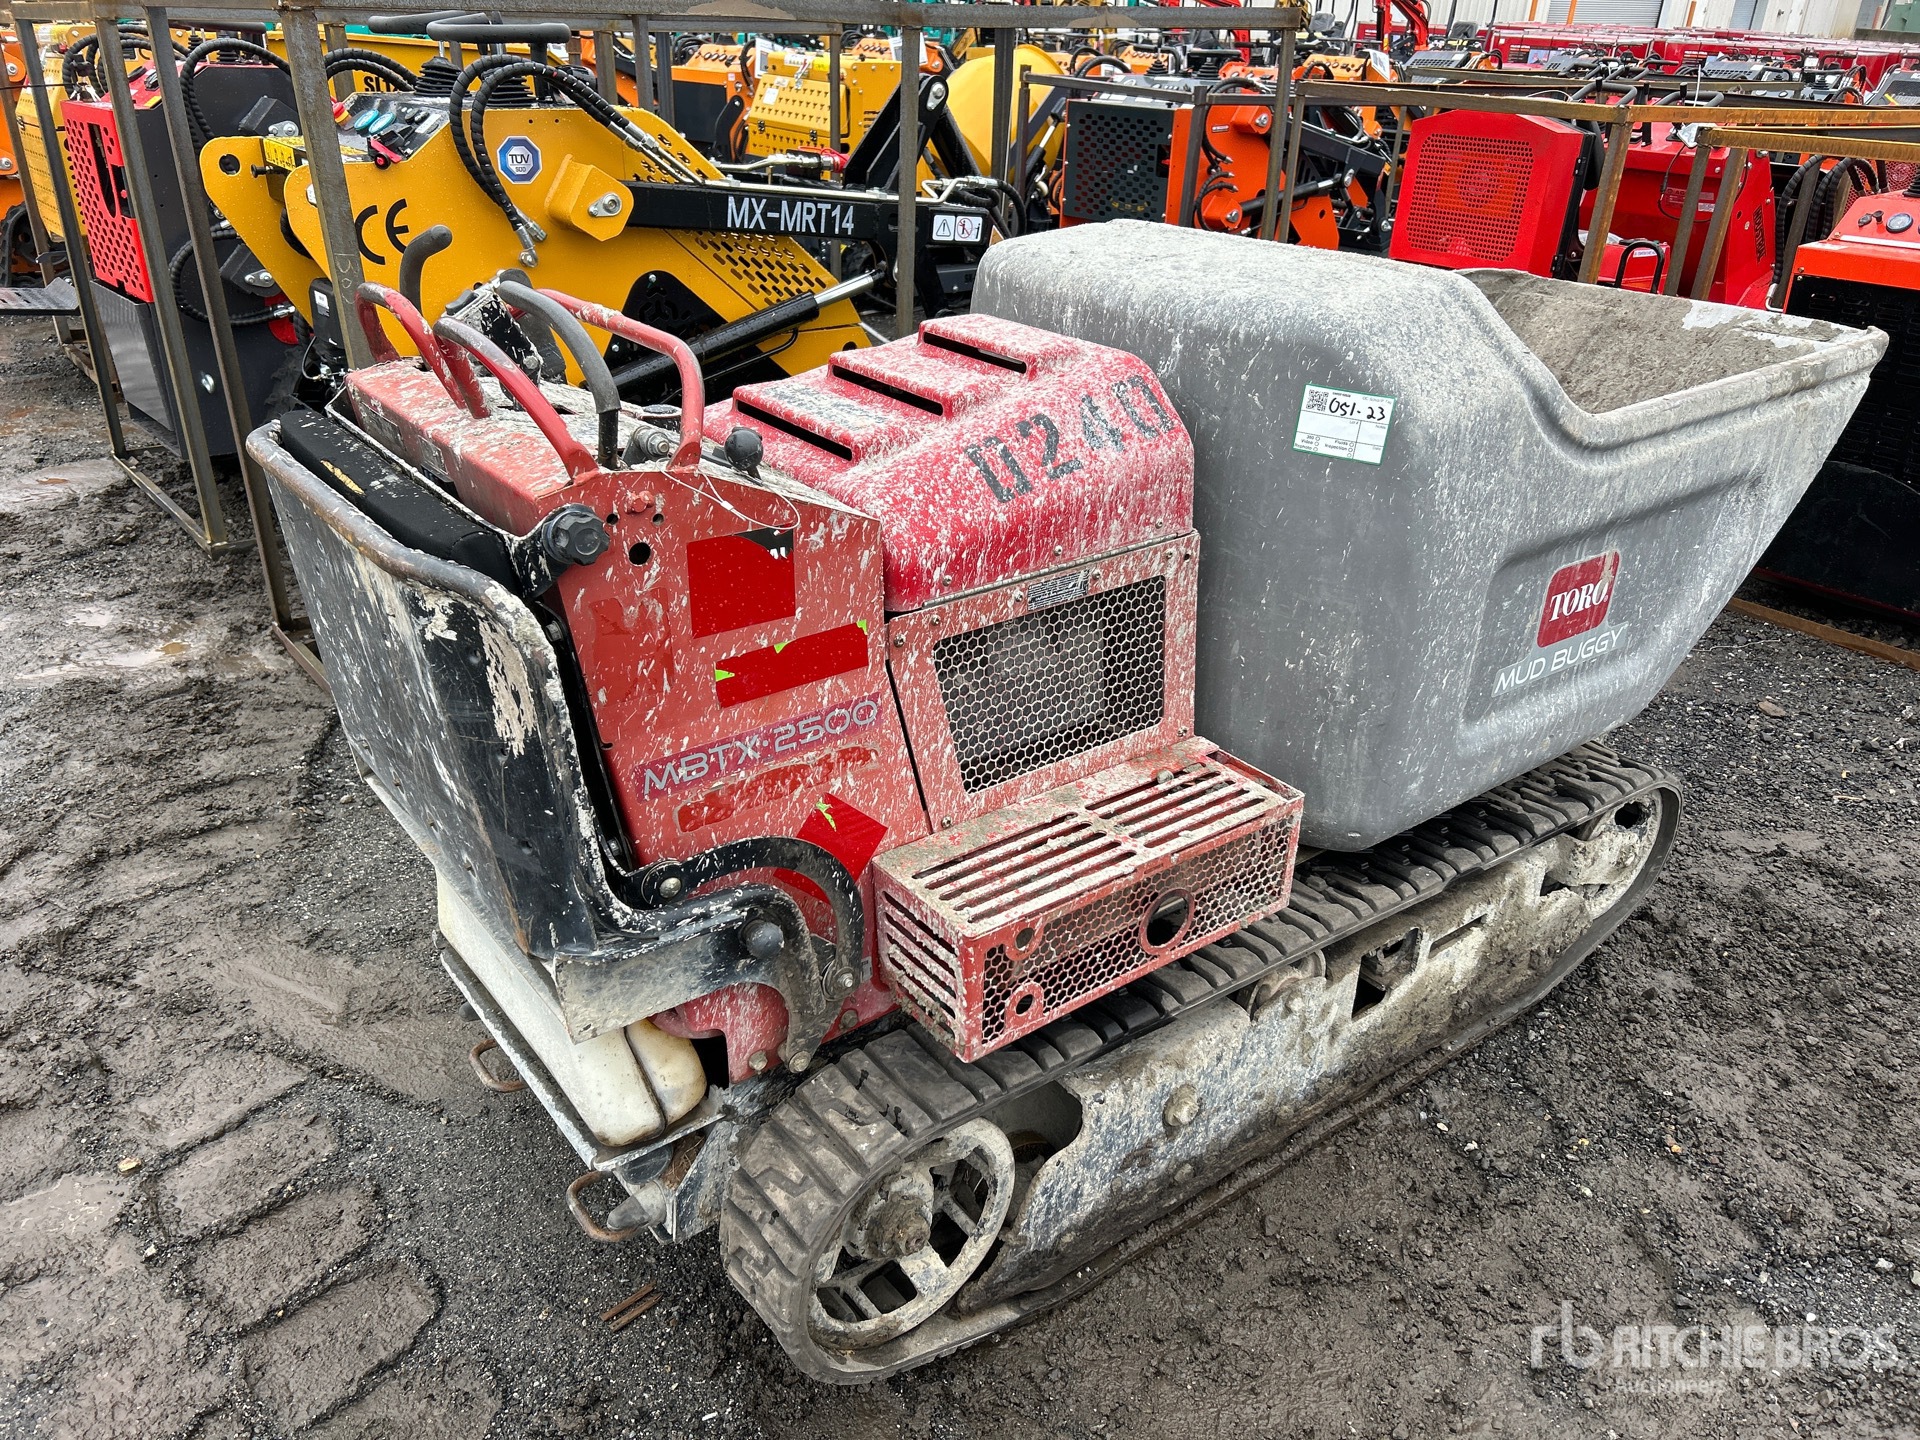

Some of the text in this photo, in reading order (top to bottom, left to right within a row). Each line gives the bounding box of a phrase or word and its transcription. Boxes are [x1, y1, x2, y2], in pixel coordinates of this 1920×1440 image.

[727, 195, 855, 235] MX-MRT14
[1549, 579, 1609, 622] TORO
[1494, 627, 1625, 694] MUD BUGGY
